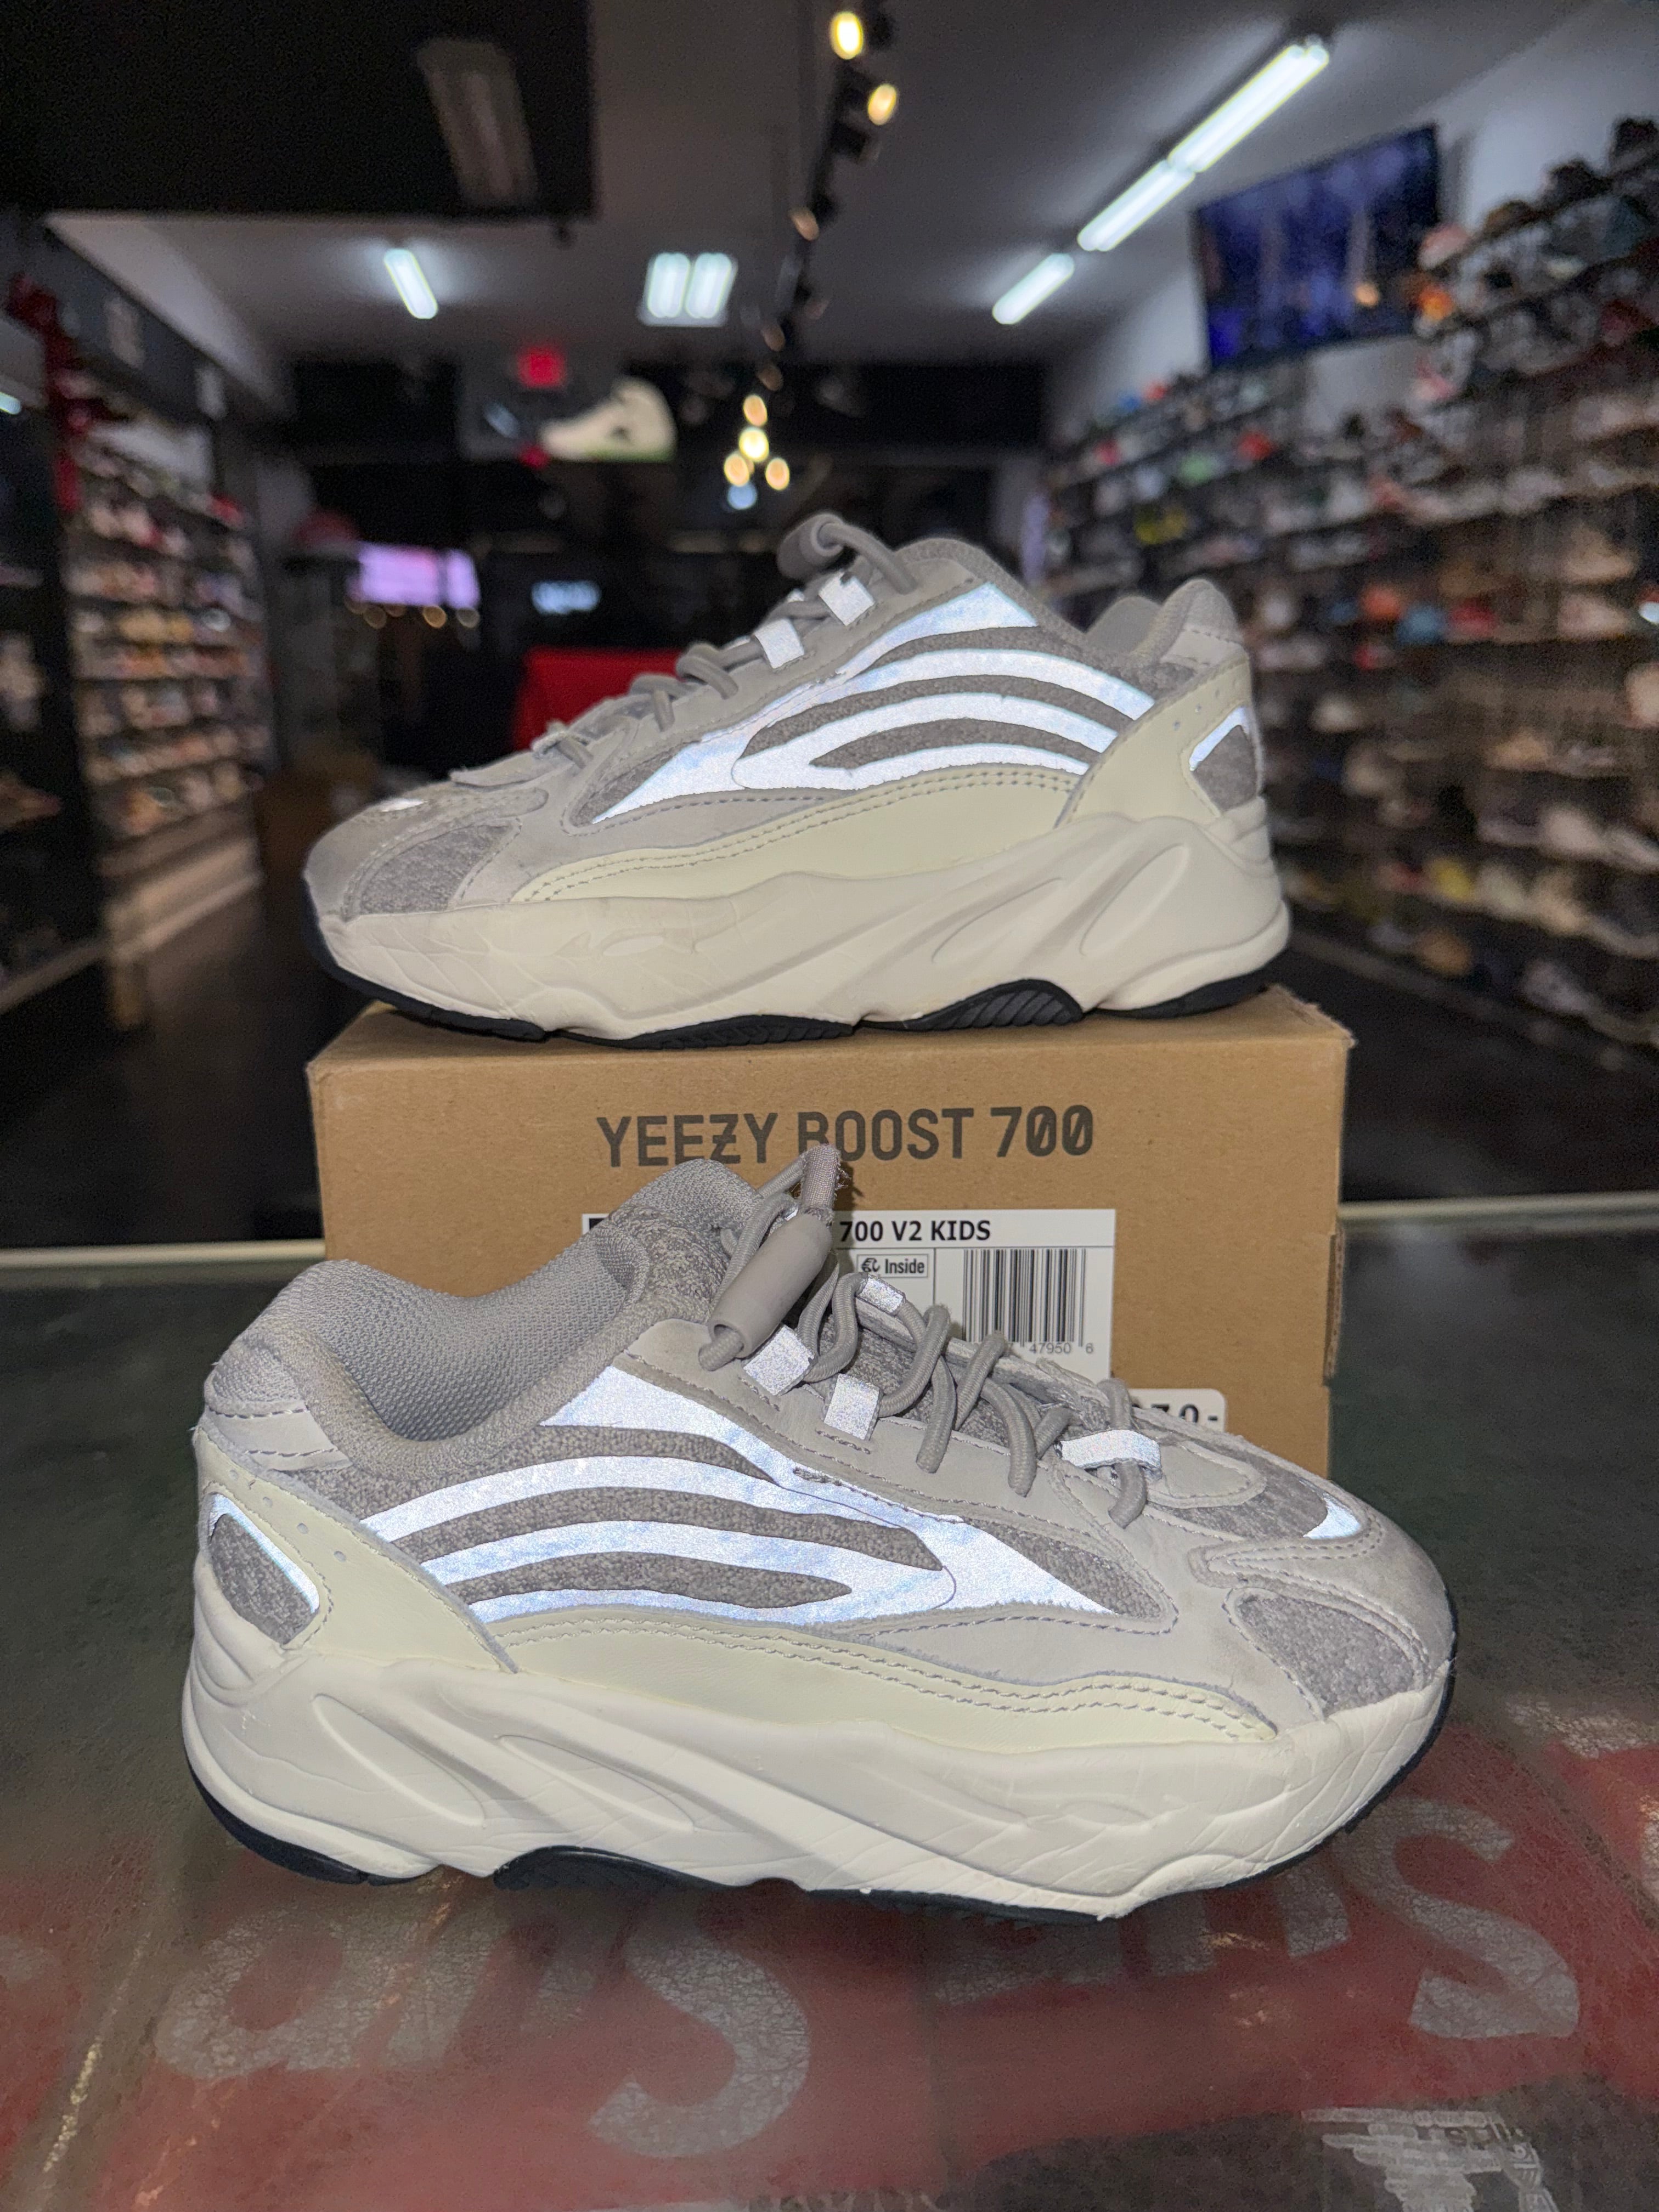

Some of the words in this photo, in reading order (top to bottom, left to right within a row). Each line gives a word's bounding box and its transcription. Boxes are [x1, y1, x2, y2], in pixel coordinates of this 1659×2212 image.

[596, 1113, 778, 1167] YEEZY
[798, 1107, 975, 1161] BOOST
[990, 1104, 1093, 1158] 700
[839, 1221, 884, 1242] 700
[891, 1220, 922, 1241] V2
[930, 1220, 991, 1241] KIDS
[885, 1258, 925, 1274] Inside
[1029, 1342, 1072, 1354] 47950
[1085, 1342, 1094, 1354] 6
